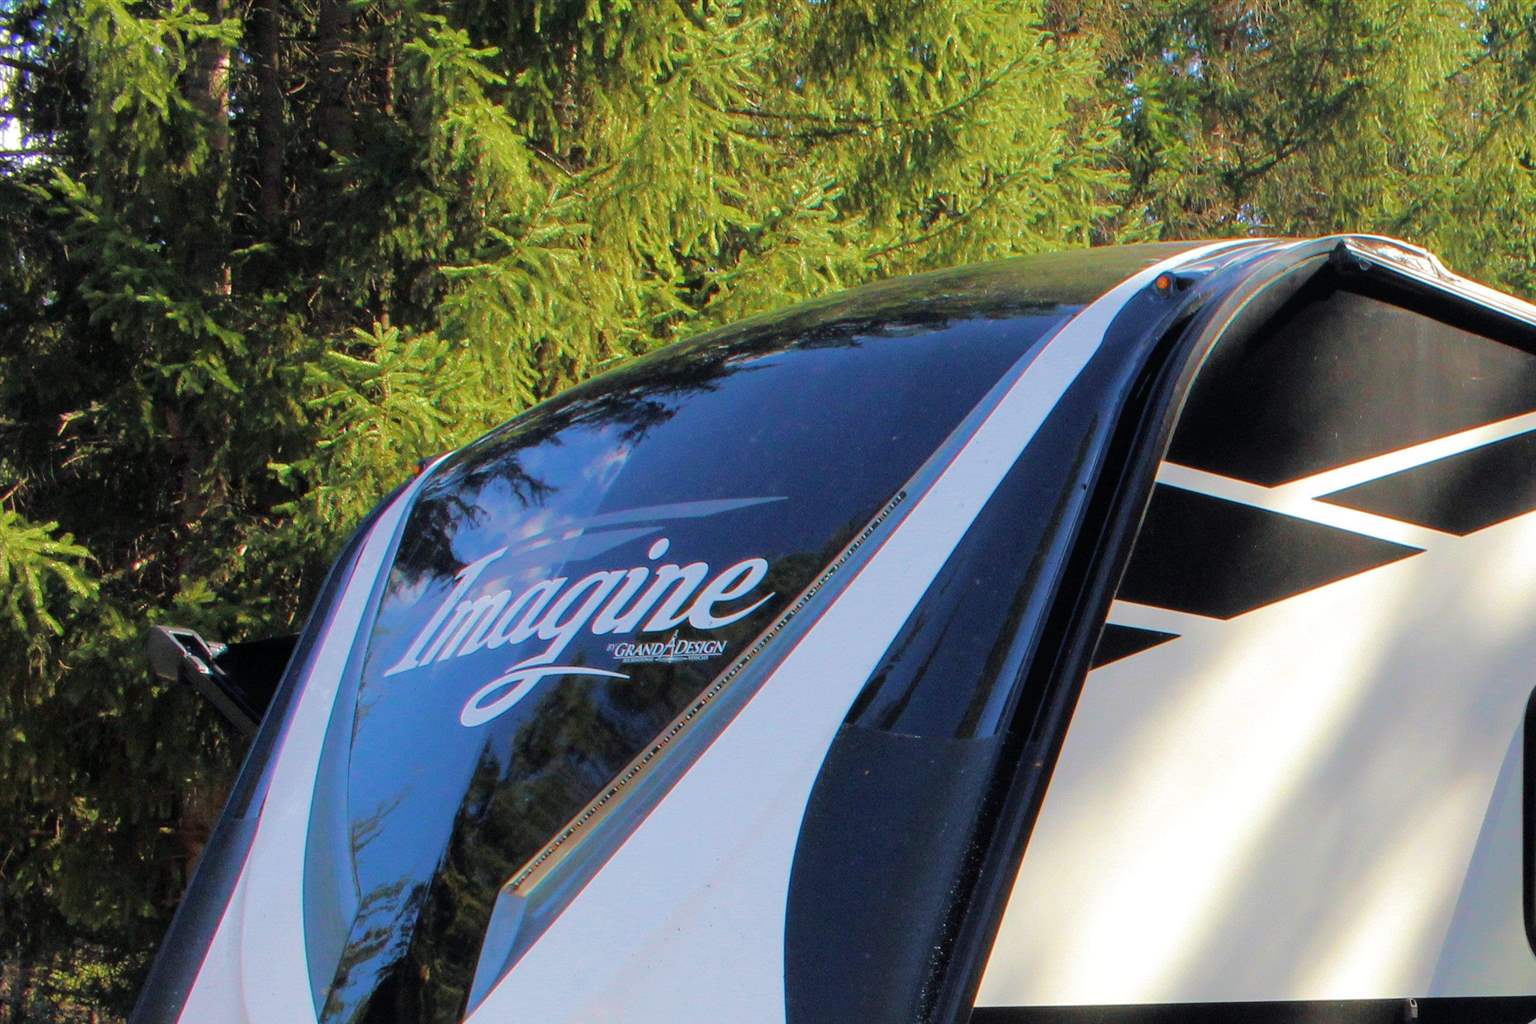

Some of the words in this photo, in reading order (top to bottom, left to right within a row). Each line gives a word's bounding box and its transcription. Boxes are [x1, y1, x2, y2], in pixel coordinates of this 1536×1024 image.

[384, 538, 776, 728] Imagine
[614, 642, 665, 657] GRAND
[674, 640, 728, 655] DESIGN
